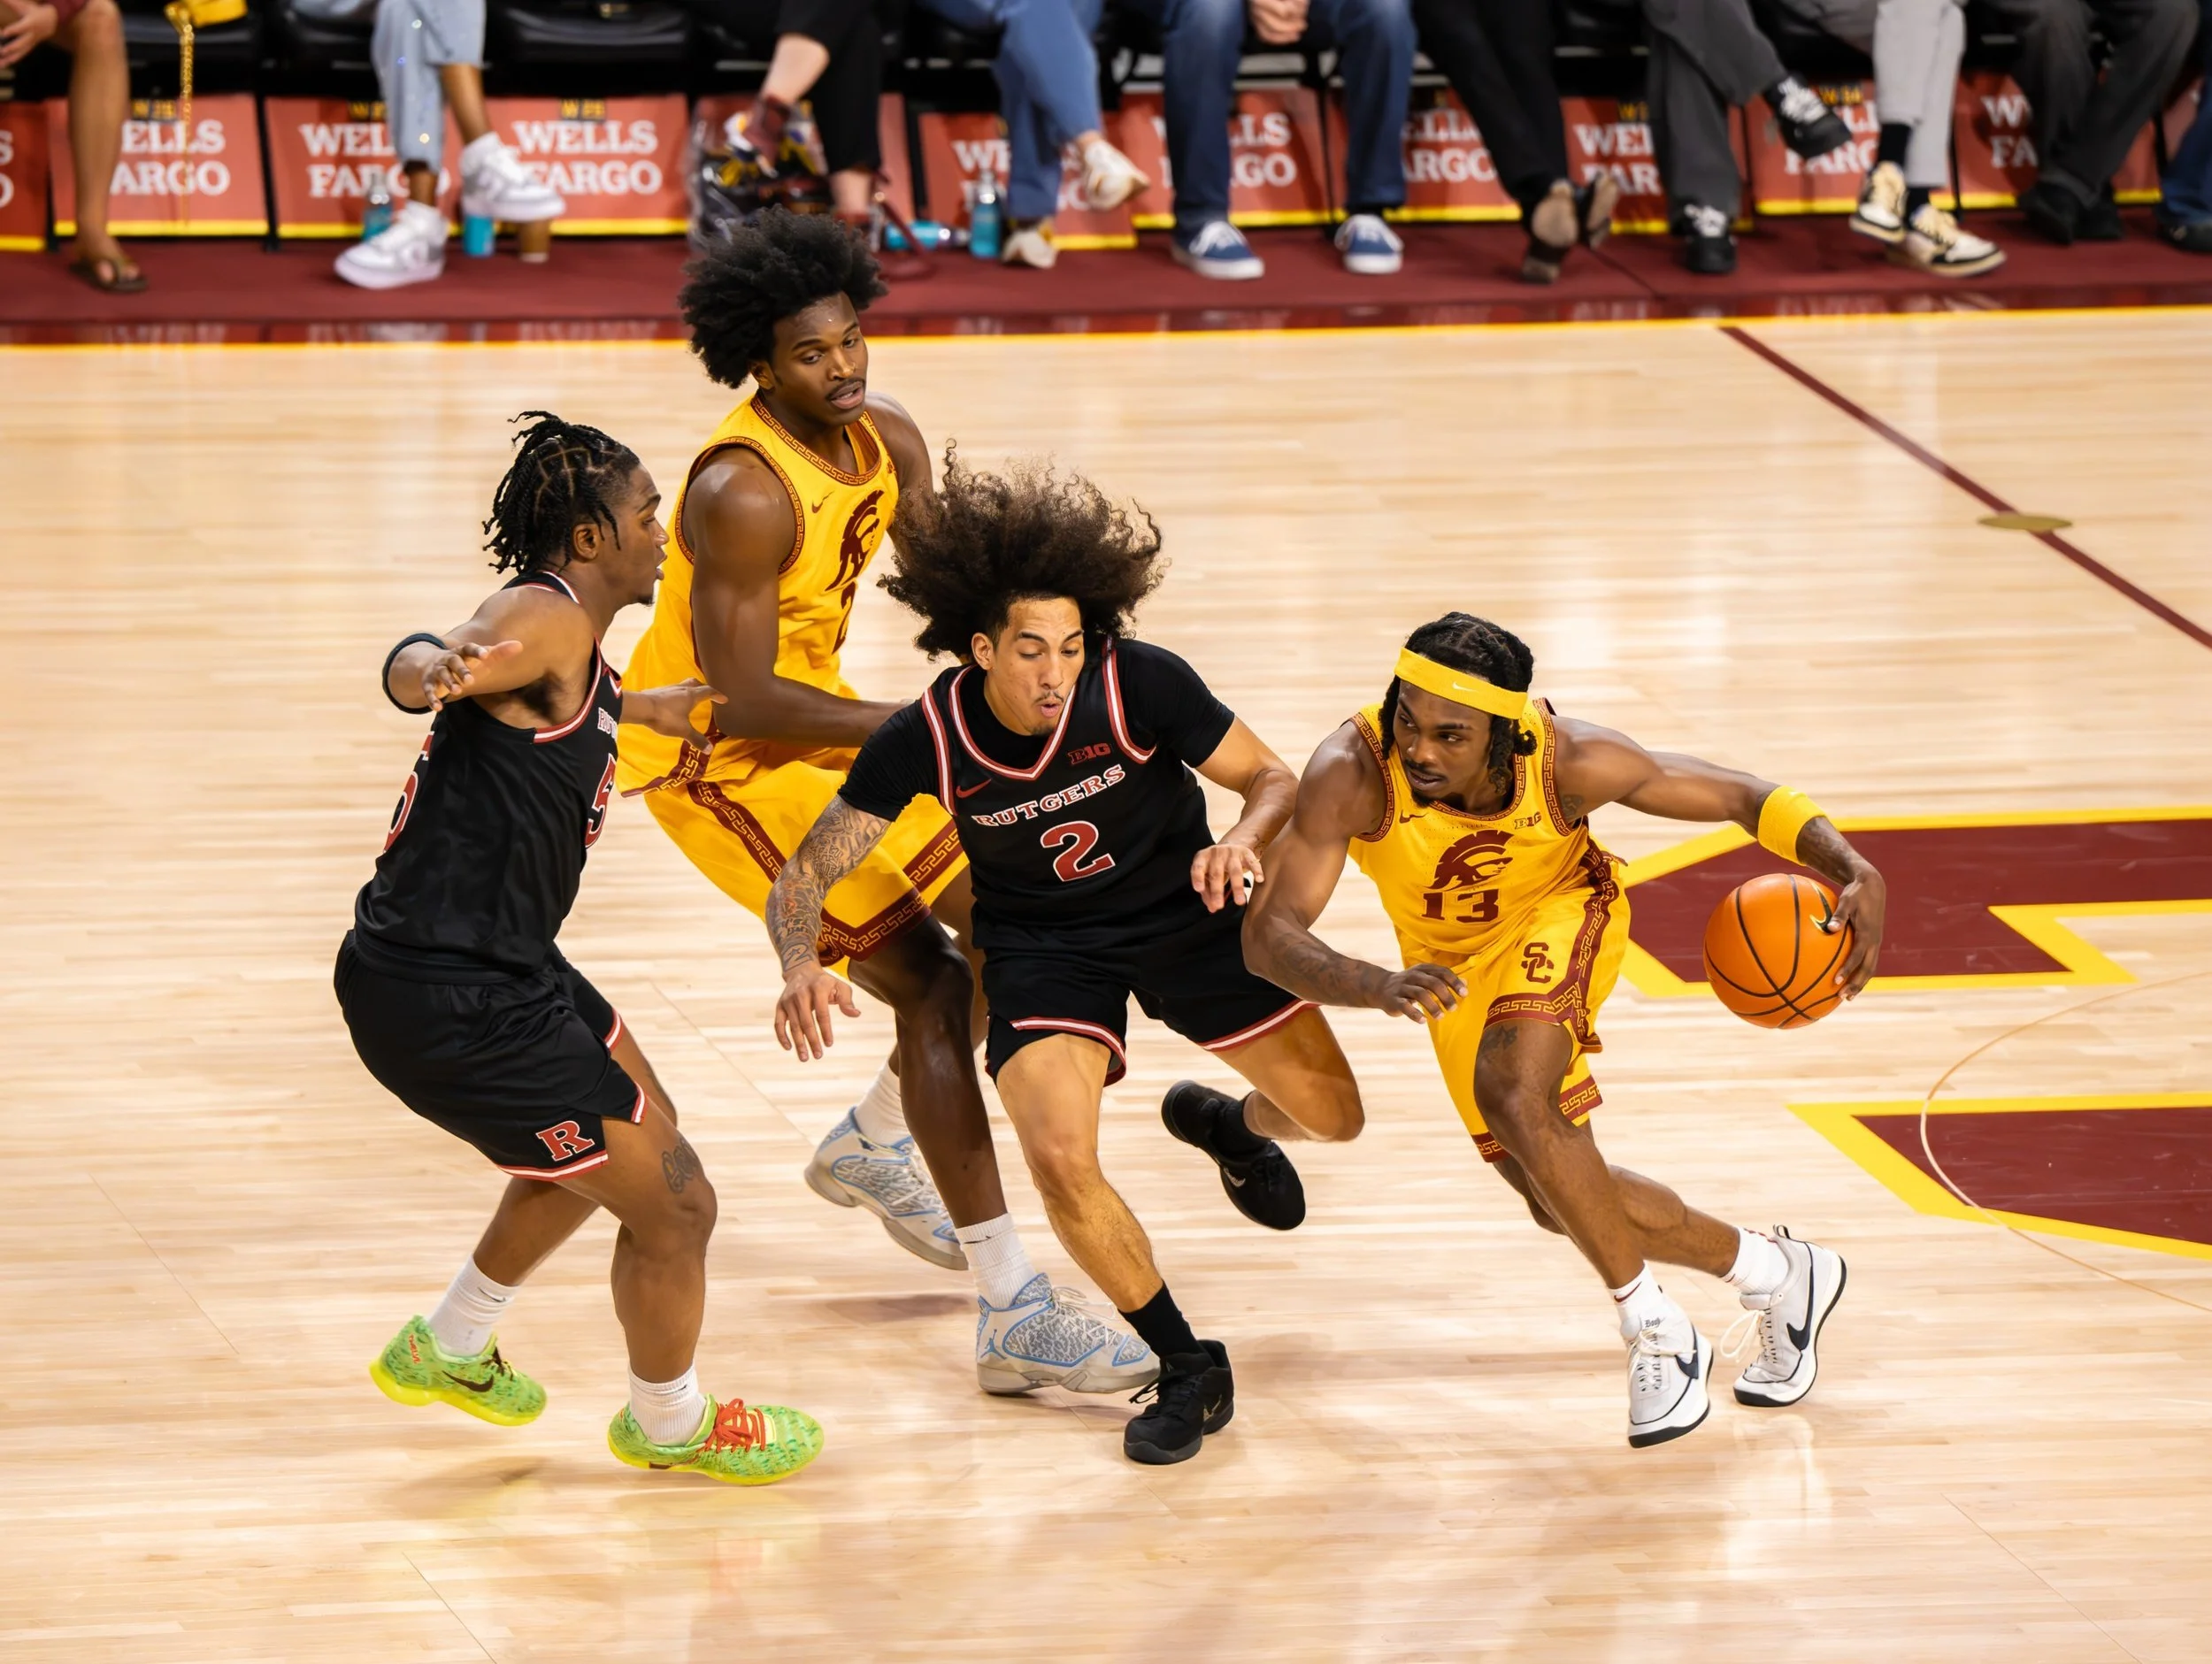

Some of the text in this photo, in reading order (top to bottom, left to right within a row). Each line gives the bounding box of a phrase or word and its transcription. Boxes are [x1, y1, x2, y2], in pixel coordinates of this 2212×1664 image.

[121, 119, 227, 155] ELLS
[298, 122, 396, 157] WEL
[512, 119, 658, 155] WELLS
[110, 159, 231, 196] ARGO
[971, 763, 1126, 827] RUTGERS
[1040, 820, 1117, 882] 2
[1421, 887, 1500, 924] 13
[535, 1120, 595, 1162] R
